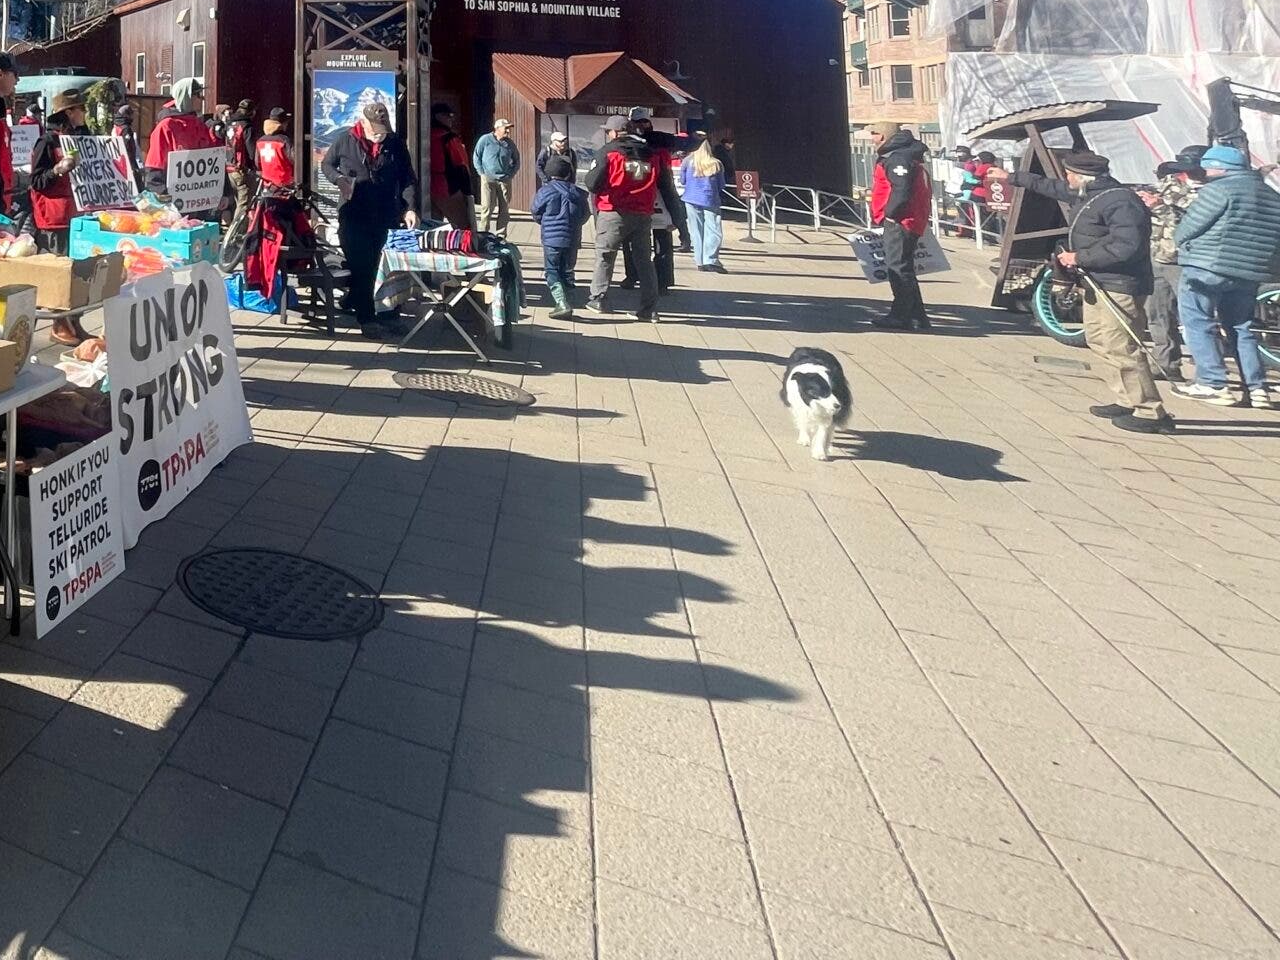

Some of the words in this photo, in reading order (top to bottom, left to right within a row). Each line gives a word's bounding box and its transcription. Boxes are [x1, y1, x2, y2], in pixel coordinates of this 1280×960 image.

[477, 0, 495, 11] SAN
[497, 0, 530, 13] SOPHIA
[531, 2, 538, 14] &
[540, 3, 585, 16] MOUNTAIN
[586, 6, 621, 18] VILLAGE
[606, 106, 654, 116] INFORN
[99, 137, 121, 161] MTN
[71, 159, 115, 183] WORKERS
[175, 157, 220, 179] 100%
[75, 182, 119, 207] TELLURIDE
[174, 180, 219, 192] SOLIDARITY
[186, 197, 211, 209] TPSPA
[118, 333, 224, 456] STRONG
[40, 469, 76, 501] HONK
[77, 461, 88, 479] IF
[87, 446, 109, 474] YOU
[52, 475, 103, 522] SUPPORT
[48, 496, 108, 550] TELLURIDE
[48, 551, 68, 579] SKI
[70, 522, 111, 565] PATROL
[62, 561, 102, 606] TPSPA
